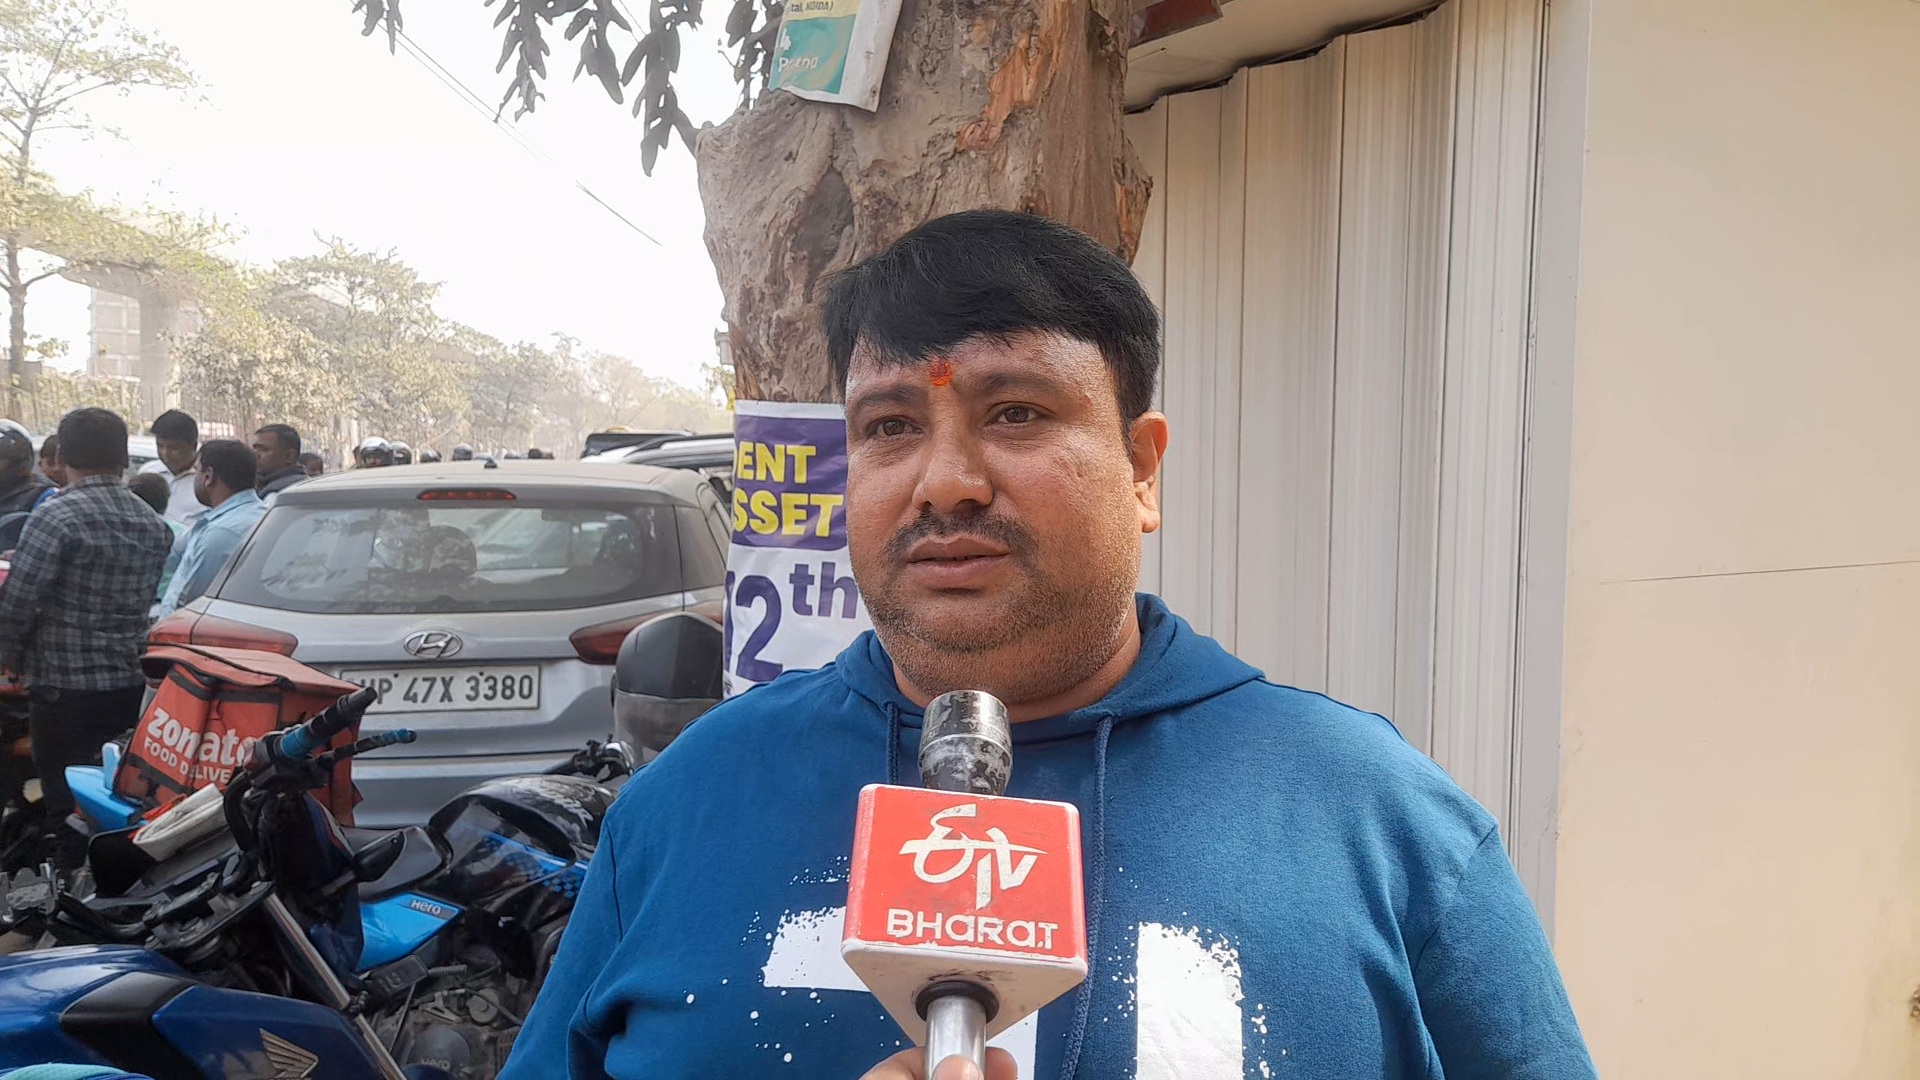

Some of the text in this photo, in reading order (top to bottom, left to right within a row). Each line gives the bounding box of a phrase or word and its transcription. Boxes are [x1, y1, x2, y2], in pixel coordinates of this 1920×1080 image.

[734, 441, 816, 485] ENT
[402, 676, 454, 704] 47X
[465, 674, 534, 702] 3380
[143, 736, 179, 768] FOOD
